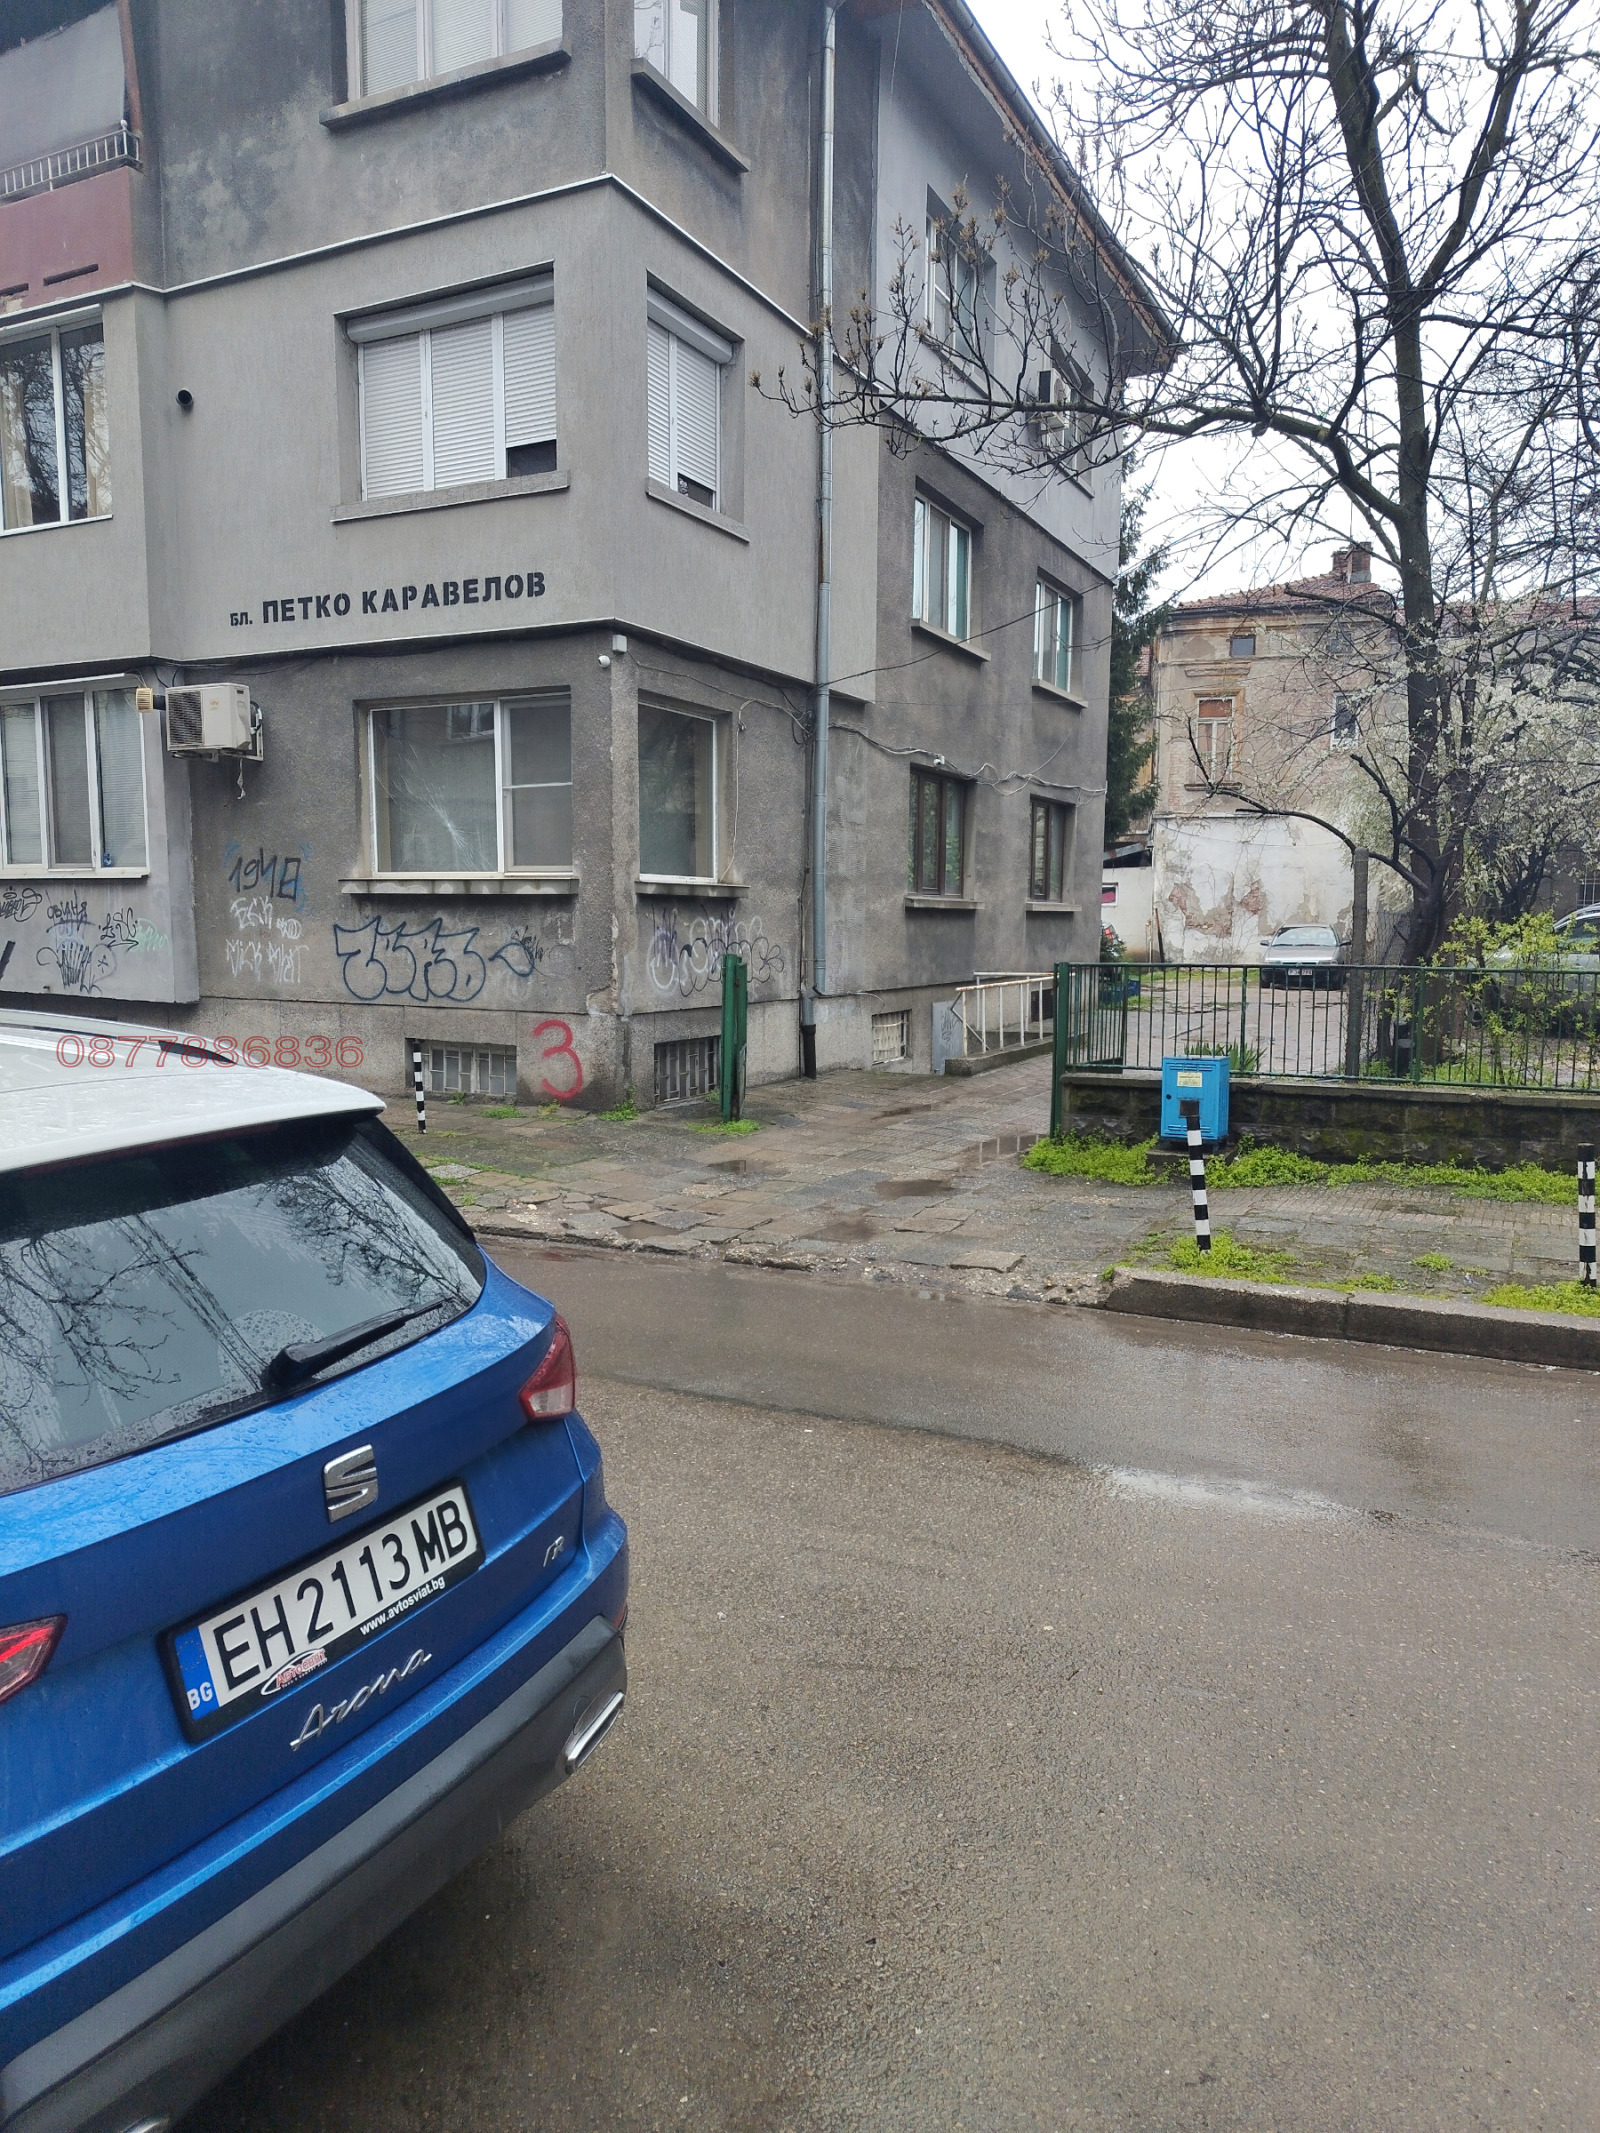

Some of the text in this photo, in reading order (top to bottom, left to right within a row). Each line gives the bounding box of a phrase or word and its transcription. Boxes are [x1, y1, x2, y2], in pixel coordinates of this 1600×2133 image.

[262, 592, 351, 624] ПЕТКО
[362, 571, 546, 614] КАРАВЕЛОВ
[533, 1019, 583, 1099] 3
[359, 1575, 446, 1637] www.avtosviat.bg
[186, 1681, 213, 1712] BG
[289, 1648, 432, 1752] Arona
